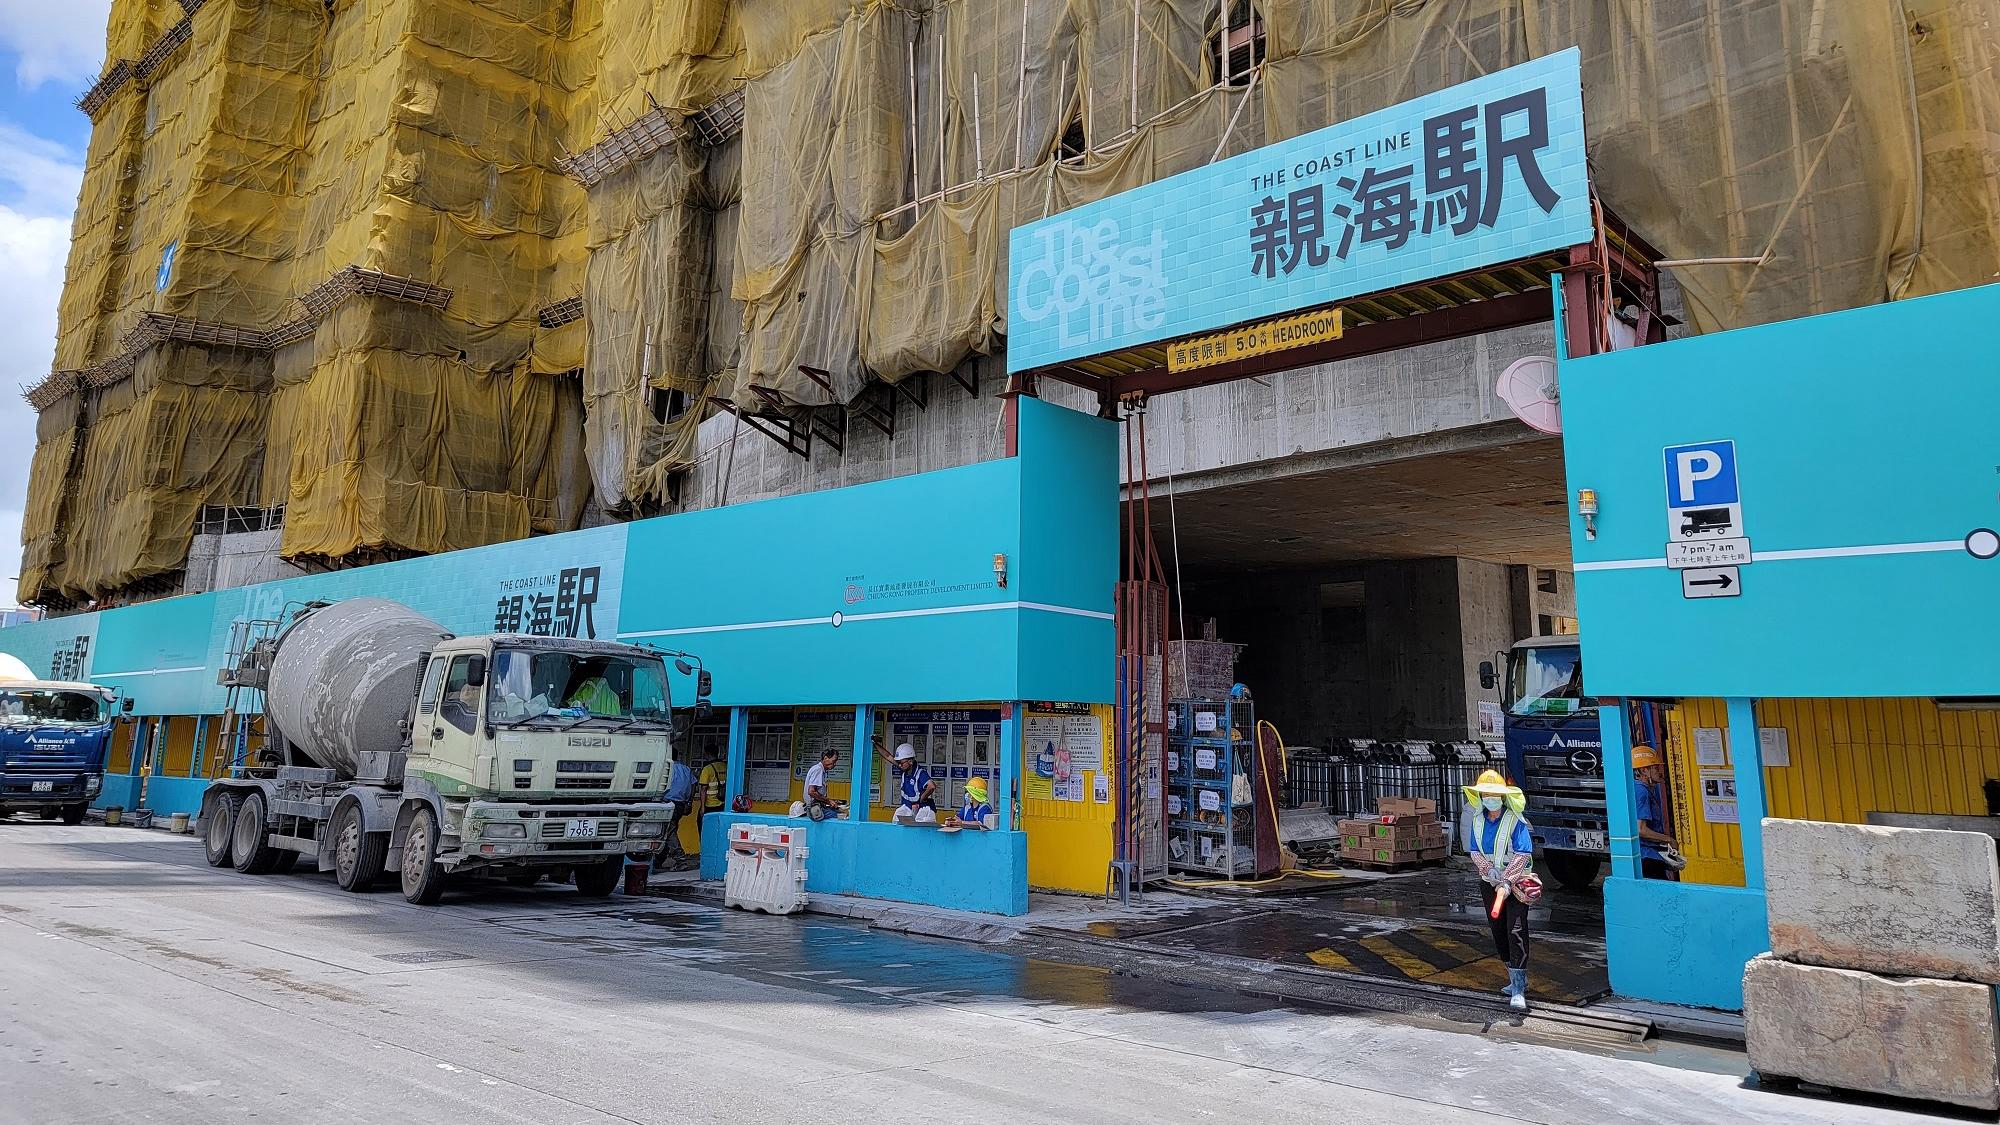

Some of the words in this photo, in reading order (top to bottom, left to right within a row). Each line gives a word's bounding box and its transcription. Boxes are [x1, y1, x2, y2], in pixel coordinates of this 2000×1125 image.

[1251, 169, 1286, 191] THE
[1293, 148, 1357, 179] COAST
[1364, 132, 1412, 159] LINE
[1250, 87, 1561, 279] 親海駅
[1033, 218, 1120, 268] The
[1017, 229, 1169, 322] Coast
[1059, 287, 1166, 349] Line
[1175, 340, 1228, 366] 高度限制
[1235, 336, 1257, 352] 5.0
[1272, 317, 1335, 344] HEADROOM
[1676, 449, 1722, 502] P
[1719, 544, 1734, 552] am
[1673, 554, 1745, 564] 下午七時至上午七時
[500, 580, 512, 591] THE
[515, 577, 538, 589] COAST
[539, 574, 557, 586] LINE
[568, 736, 612, 747] ISUZU
[1566, 739, 1601, 748] Alliance
[577, 820, 589, 829] TE
[570, 828, 594, 837] 7905
[1583, 831, 1596, 841] UL
[1578, 840, 1603, 849] 4576
